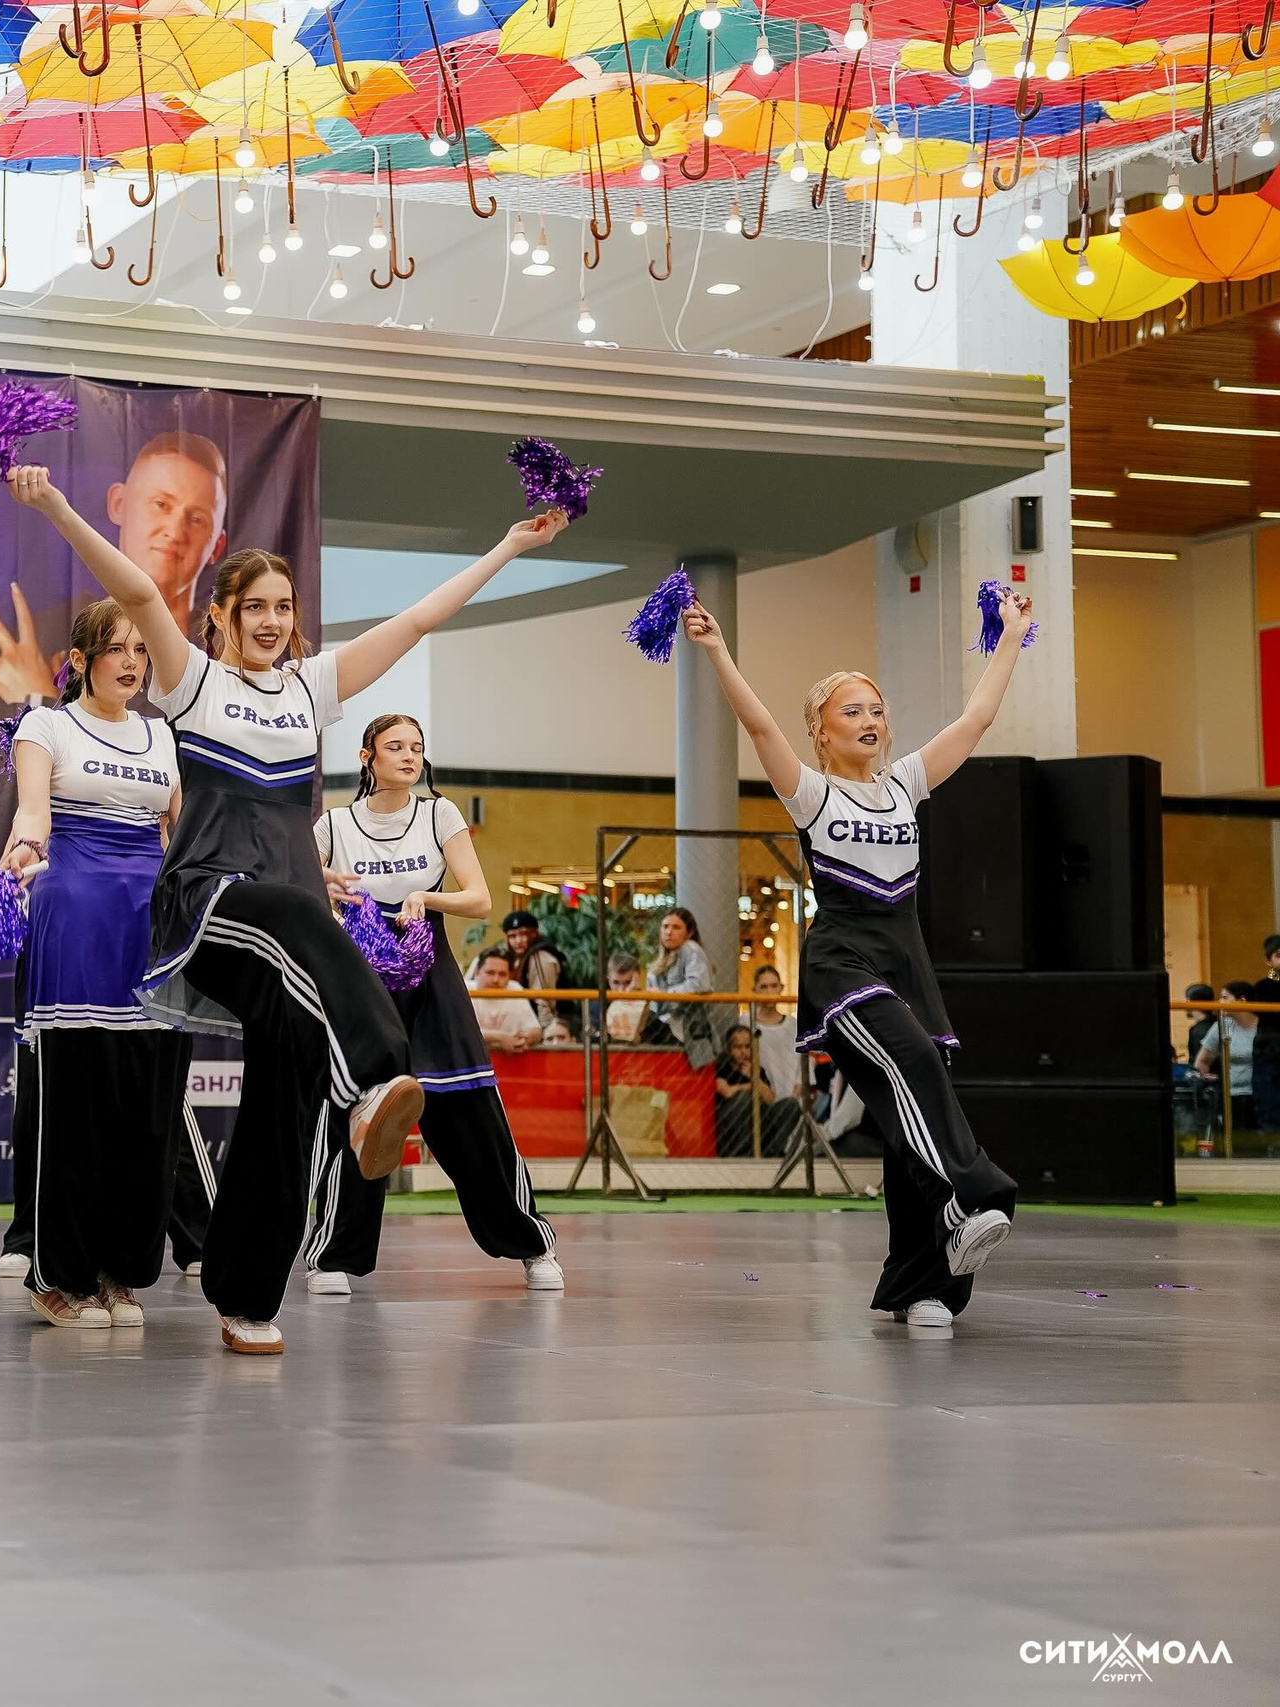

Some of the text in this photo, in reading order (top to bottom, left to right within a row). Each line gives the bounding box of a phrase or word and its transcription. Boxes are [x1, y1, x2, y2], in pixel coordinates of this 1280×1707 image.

[82, 760, 170, 787] CHEERS
[827, 819, 919, 845] CHEE
[353, 855, 428, 875] CHEERS
